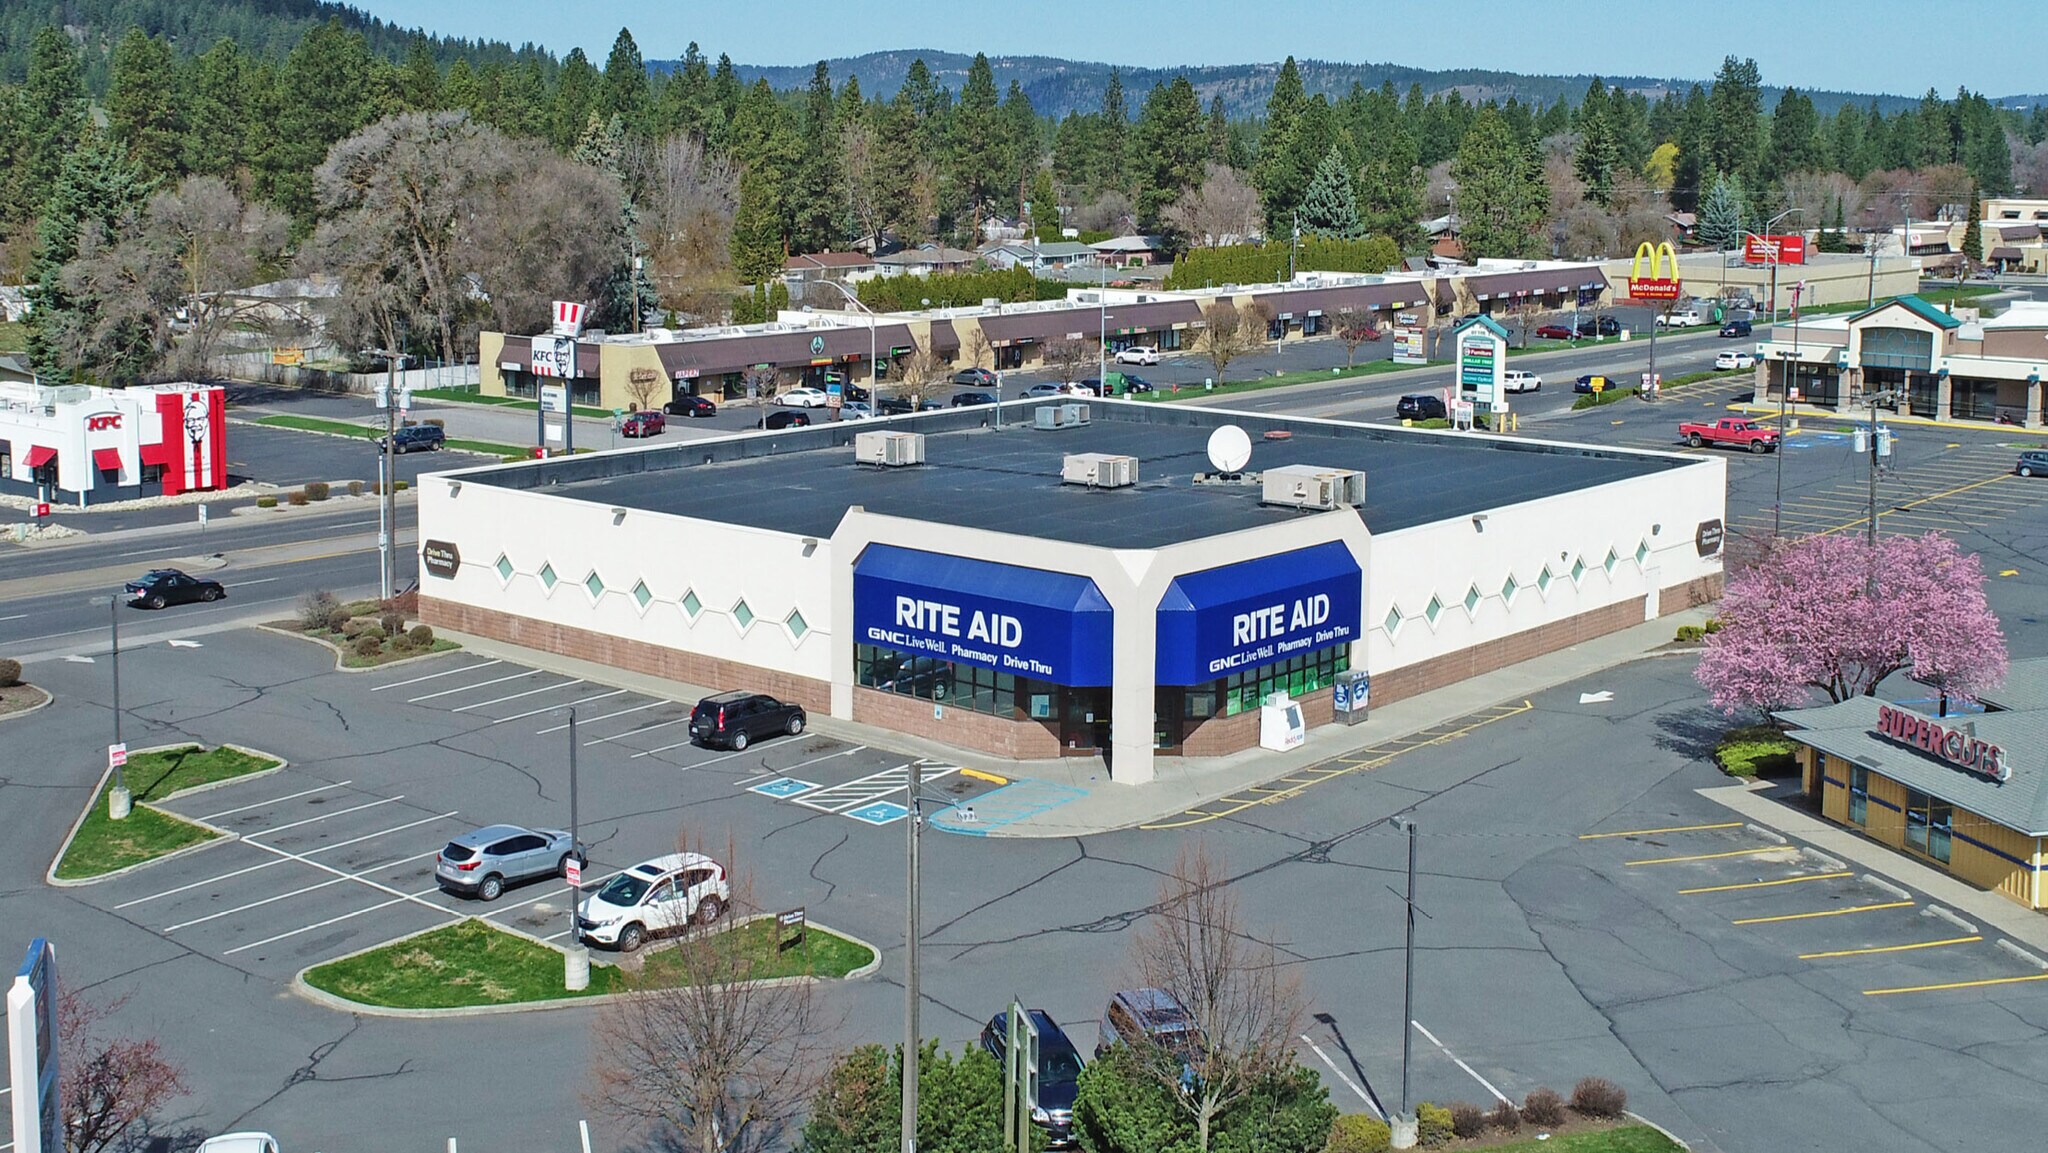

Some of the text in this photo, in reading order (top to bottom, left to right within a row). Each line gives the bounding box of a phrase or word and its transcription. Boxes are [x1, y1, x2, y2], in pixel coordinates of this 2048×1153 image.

[1631, 284, 1677, 292] McDonald's
[533, 350, 552, 363] KFC
[88, 415, 122, 432] KFC
[427, 547, 452, 559] Drive Thru
[427, 556, 452, 569] Pharmacy
[896, 595, 1023, 649] RITE AID
[1233, 593, 1330, 647] RITE AID
[867, 627, 905, 645] GNC
[951, 643, 998, 666] Pharmacy
[1003, 654, 1029, 671] Drive
[1028, 659, 1053, 675] Thru
[1209, 654, 1241, 673] GNC
[1277, 635, 1313, 654] Pharmacy
[1316, 630, 1334, 643] Drive
[1333, 625, 1350, 637] Thru
[1876, 704, 2002, 776] SUPERCUTS
